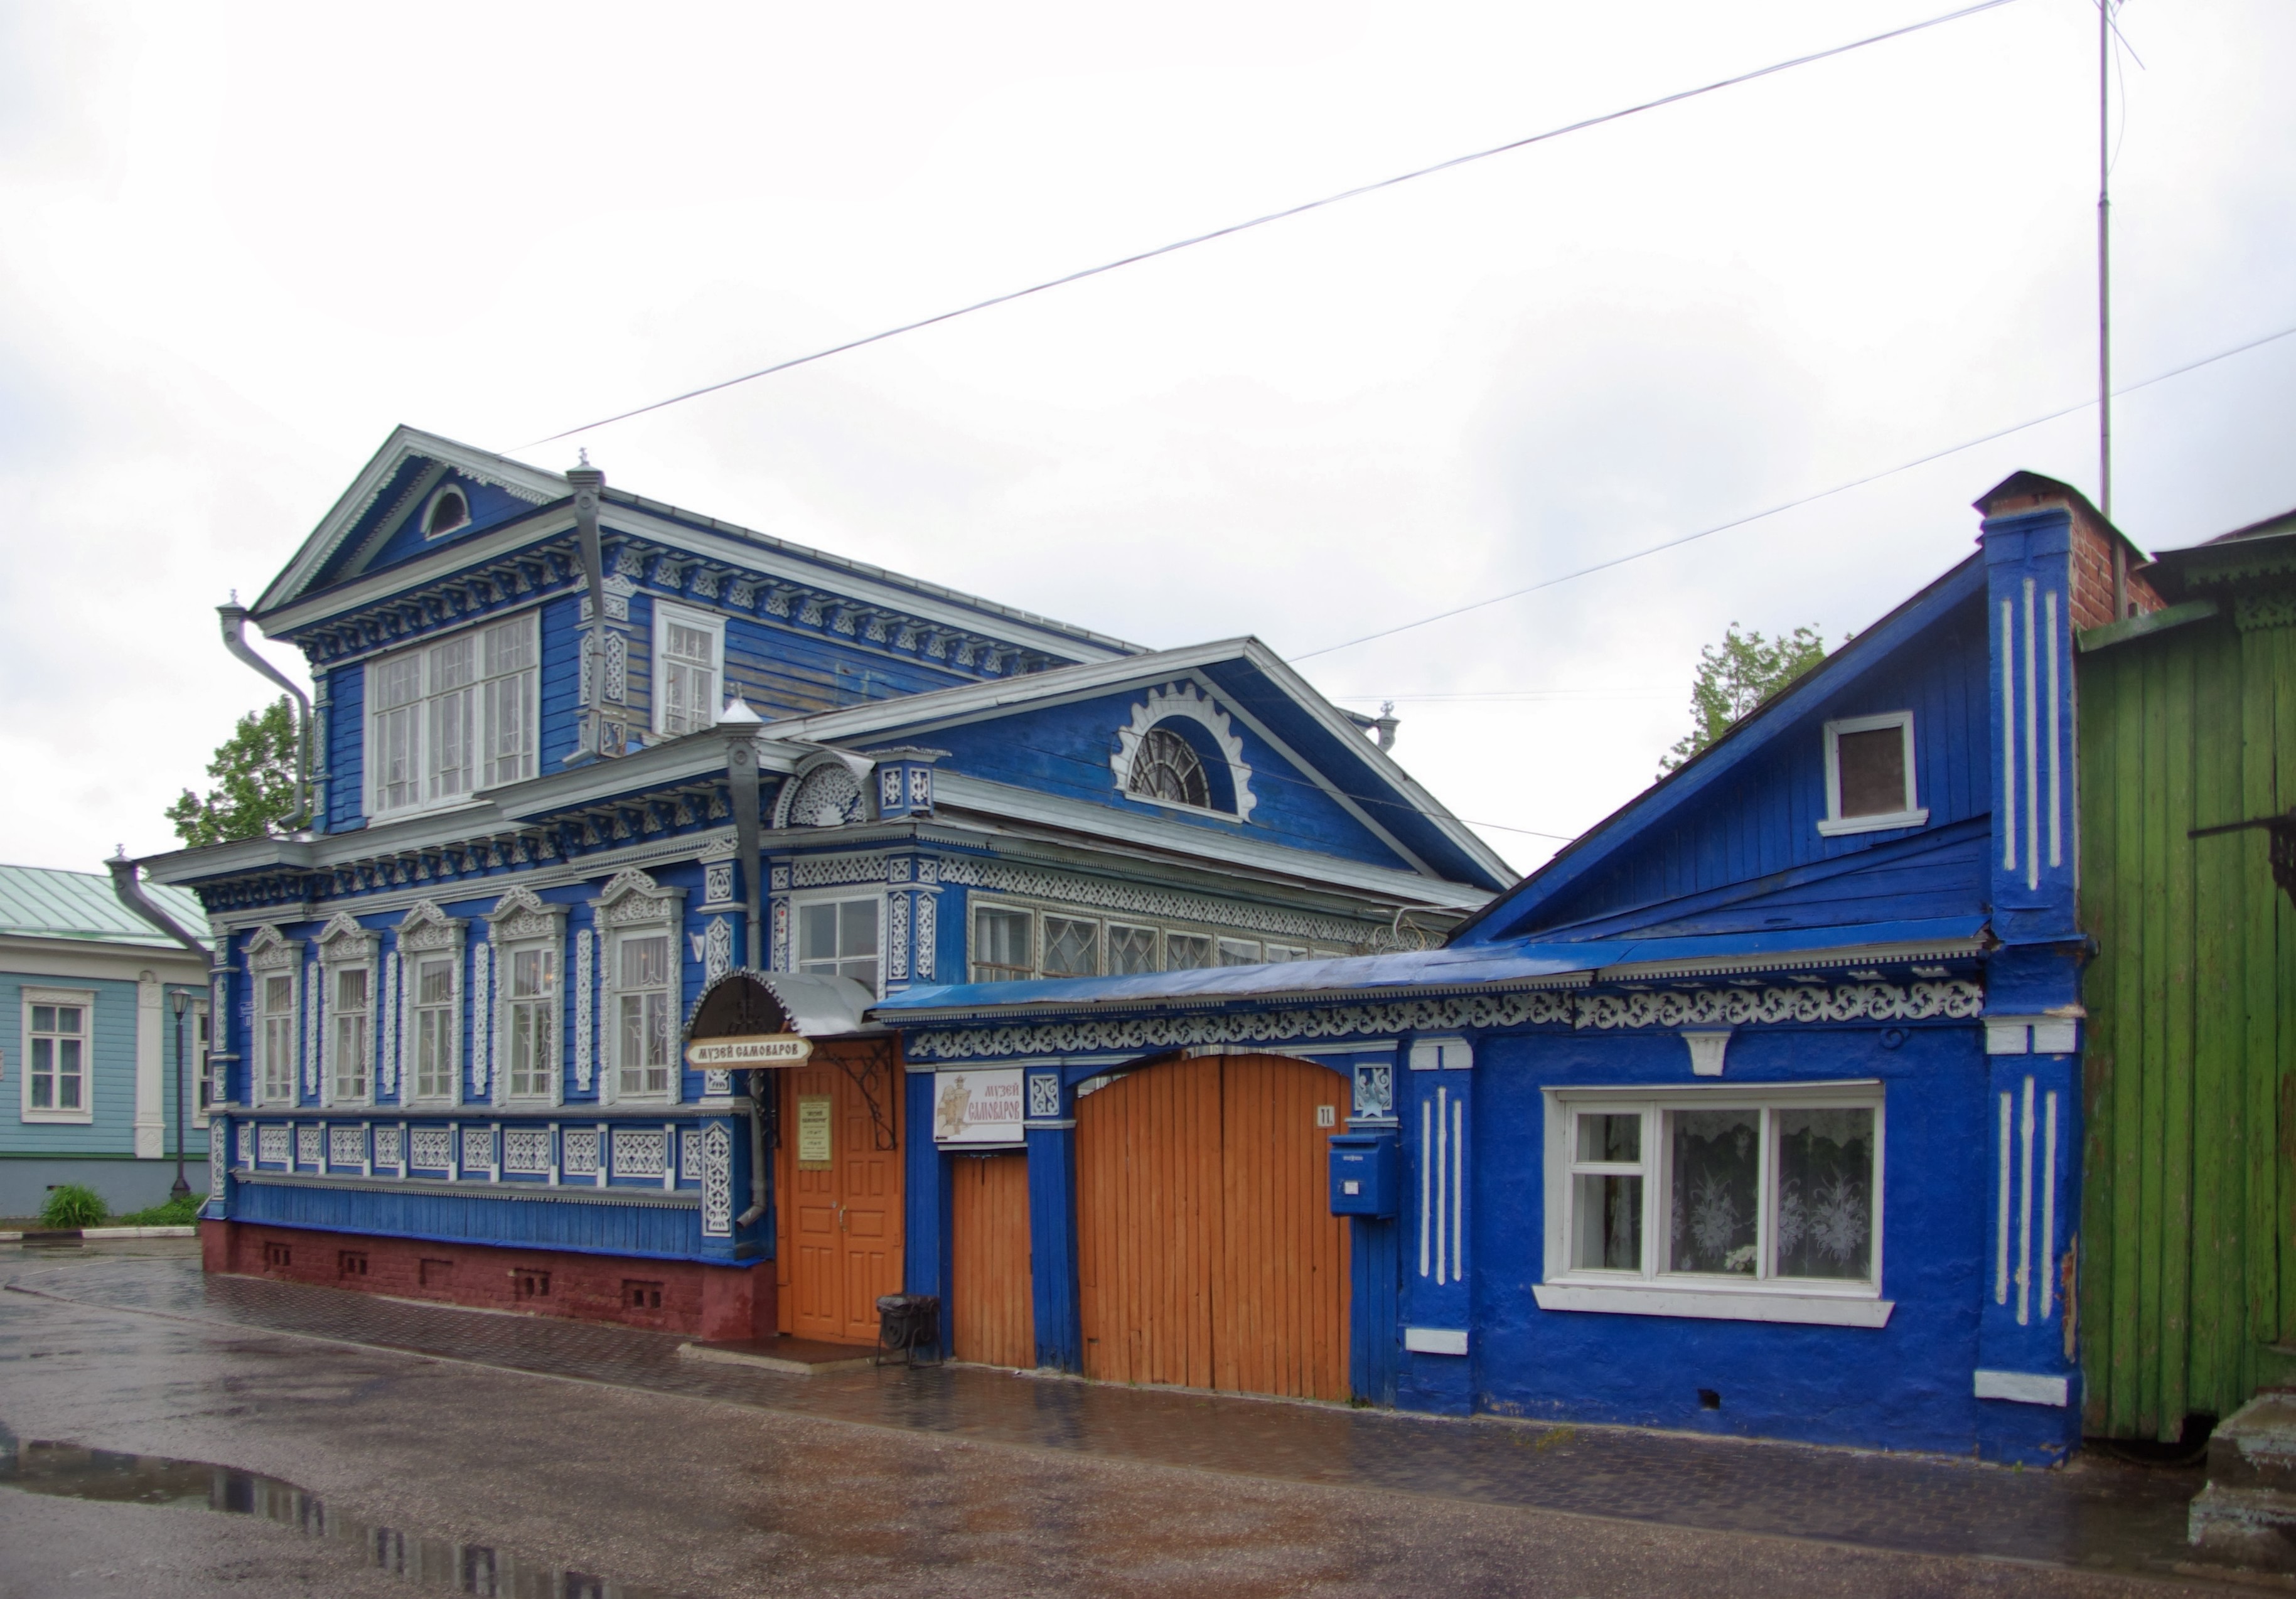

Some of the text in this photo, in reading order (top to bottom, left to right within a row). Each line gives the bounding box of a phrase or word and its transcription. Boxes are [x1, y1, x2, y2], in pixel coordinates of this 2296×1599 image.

[698, 1044, 798, 1062] МУЗЕЙ САМОВАРОВ
[984, 1082, 1019, 1099] МУЗЕЙ
[968, 1101, 1019, 1121] САМОВАРОВ
